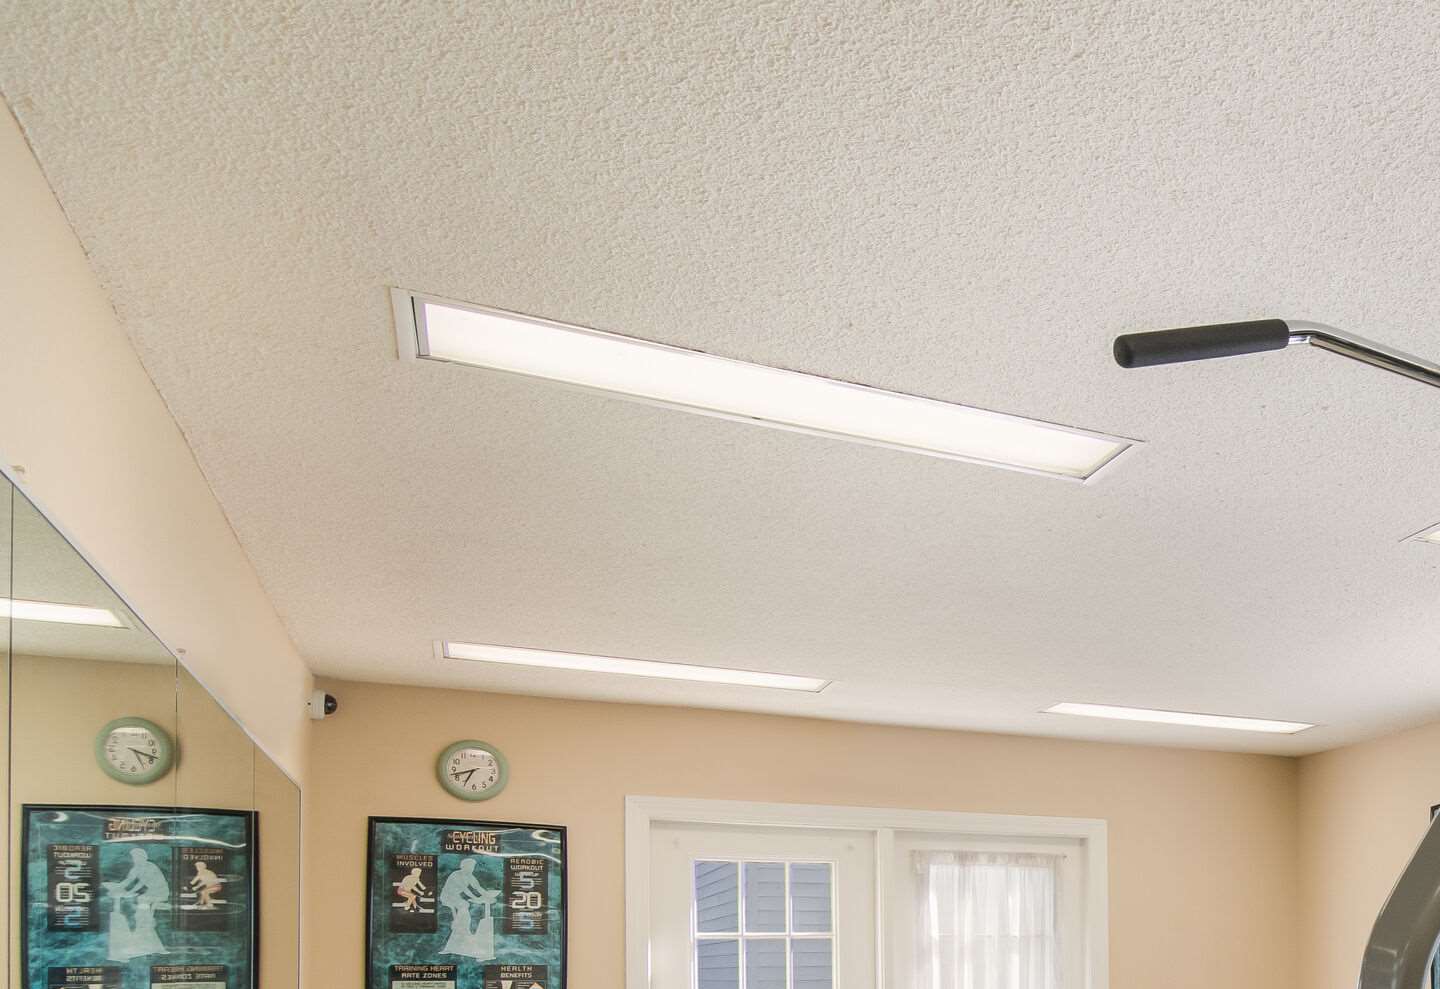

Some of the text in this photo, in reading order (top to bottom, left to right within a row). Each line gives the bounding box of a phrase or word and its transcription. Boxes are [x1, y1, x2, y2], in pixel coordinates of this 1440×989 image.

[487, 759, 493, 767] 2
[488, 775, 494, 783] 4
[471, 783, 477, 791] 6
[452, 831, 496, 845] CYCLING
[511, 891, 542, 909] 20
